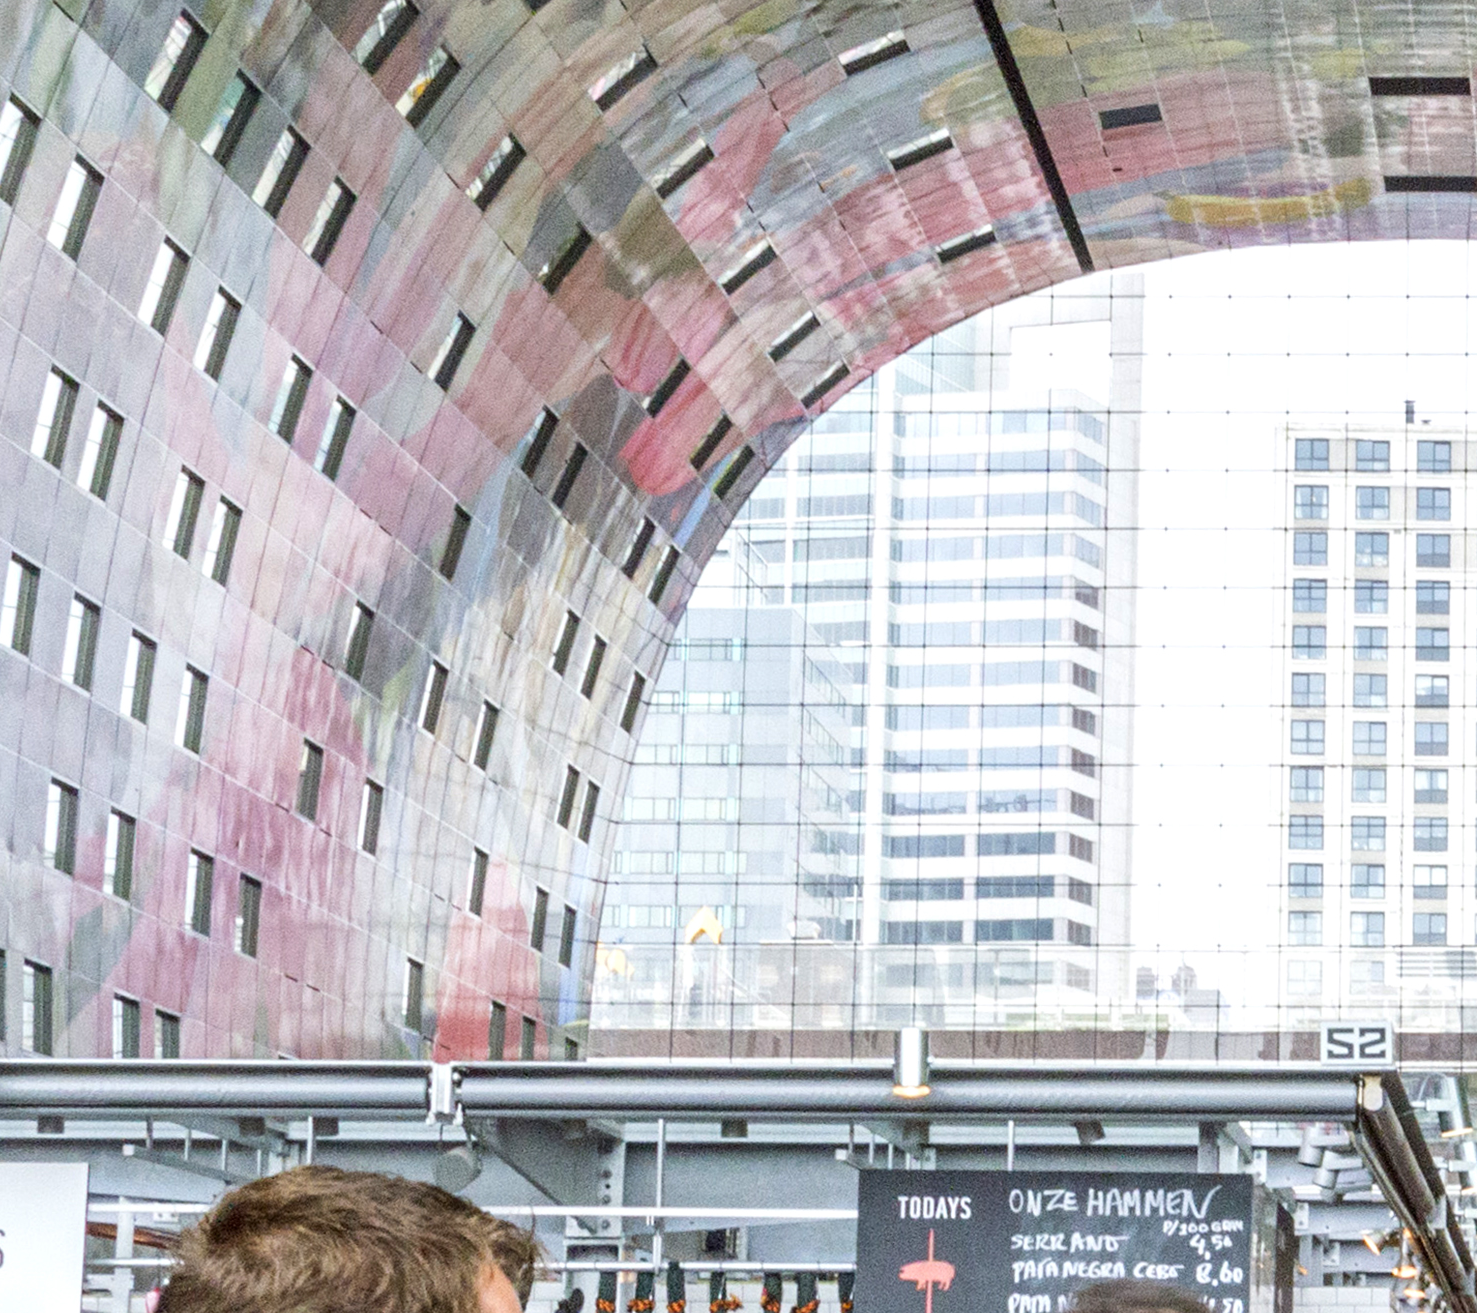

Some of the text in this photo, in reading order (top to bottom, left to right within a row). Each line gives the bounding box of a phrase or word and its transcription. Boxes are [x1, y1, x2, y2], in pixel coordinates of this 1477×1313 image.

[1327, 1027, 1386, 1059] 52
[898, 1196, 972, 1219] TODAYS
[1008, 1185, 1222, 1219] ONZE HAMMEN
[1011, 1232, 1130, 1253] SERRANO
[1062, 1260, 1125, 1278] NEGRA
